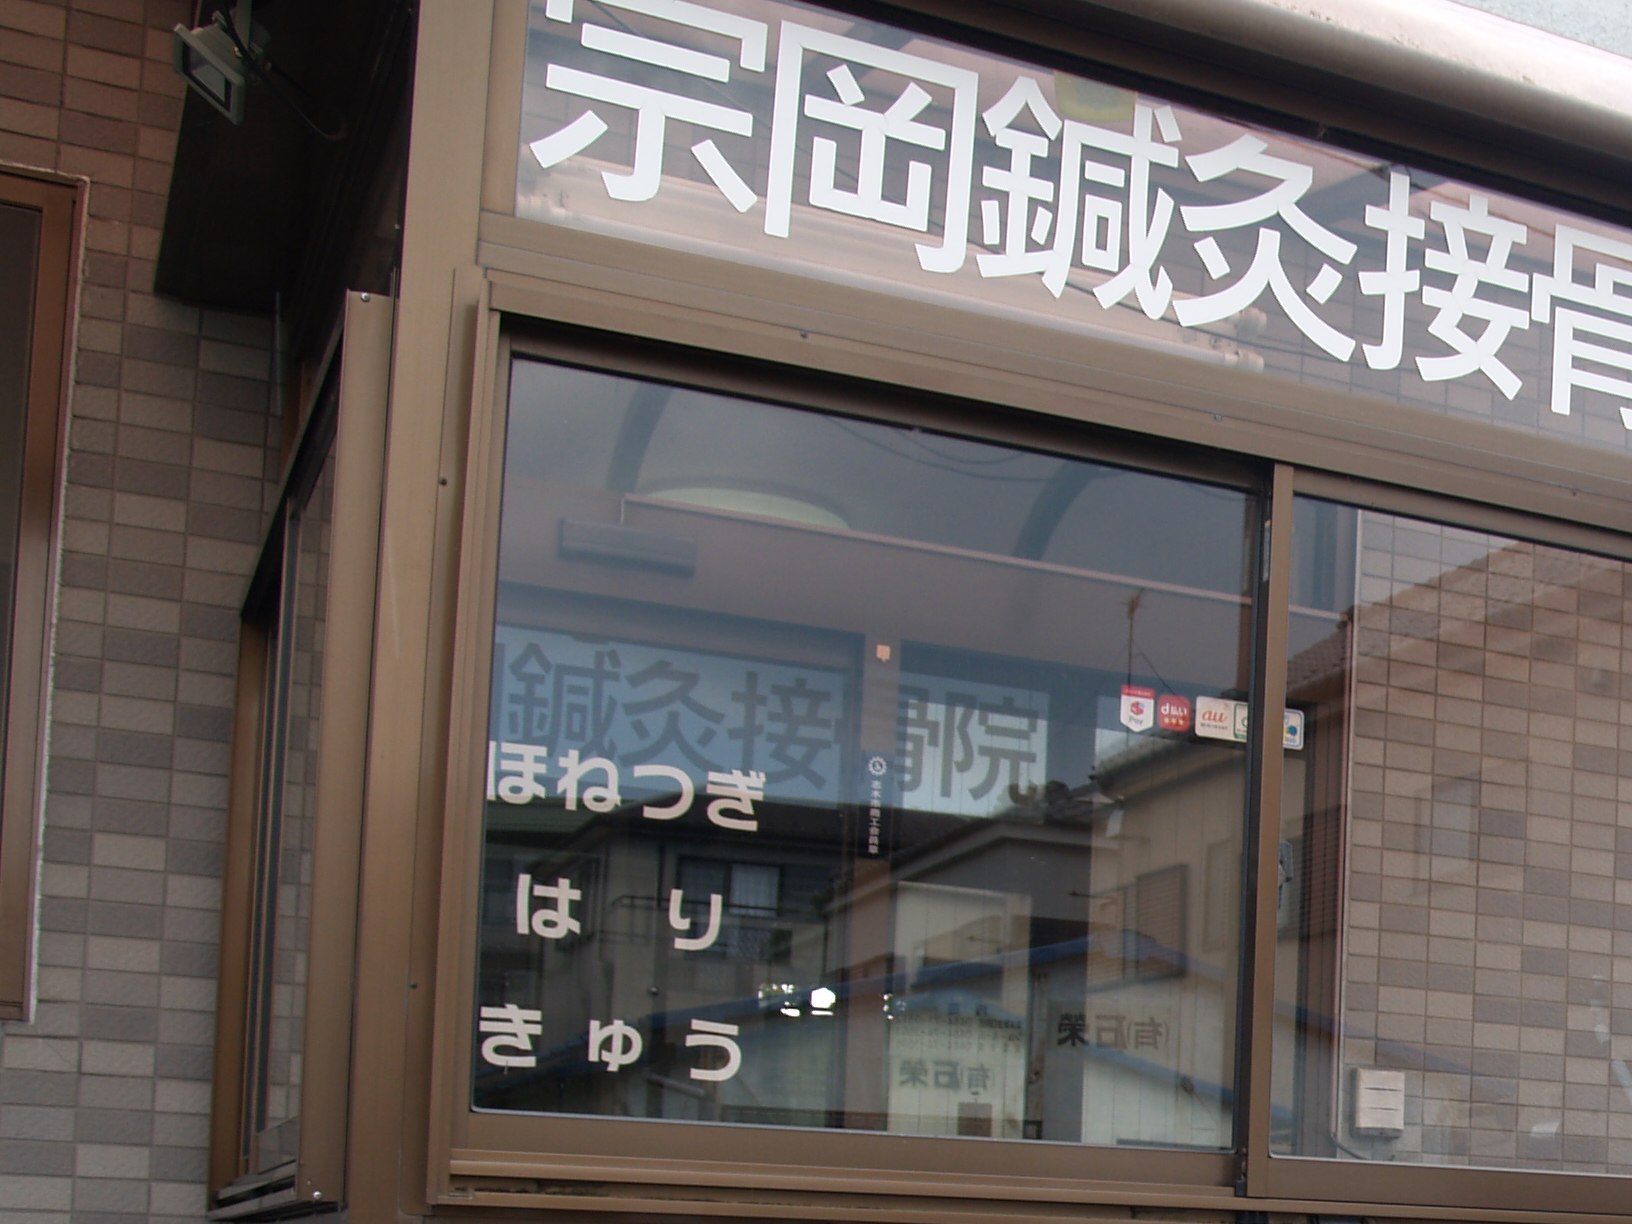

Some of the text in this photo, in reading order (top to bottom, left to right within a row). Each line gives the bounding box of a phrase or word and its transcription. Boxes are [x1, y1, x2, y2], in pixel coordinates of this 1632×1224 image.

[487, 741, 767, 832] ほねつぎ
[479, 1004, 742, 1081] きゅう
